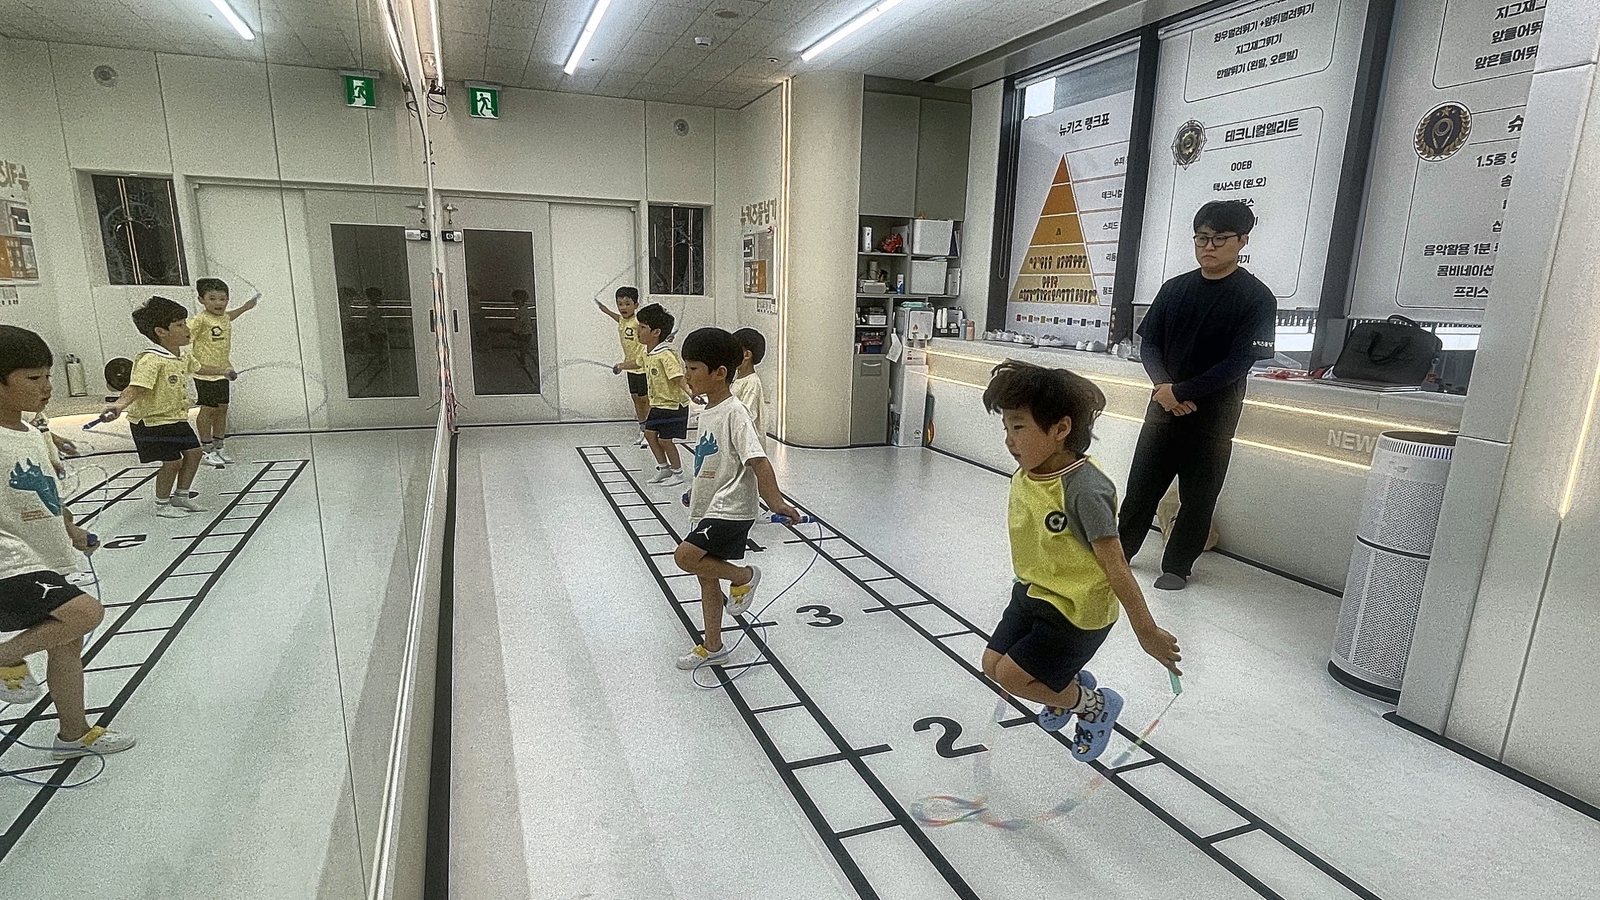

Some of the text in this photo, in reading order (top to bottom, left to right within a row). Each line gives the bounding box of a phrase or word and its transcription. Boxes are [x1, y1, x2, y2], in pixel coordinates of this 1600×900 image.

[1235, 33, 1283, 55] 지그재그뛰기
[1216, 49, 1298, 79] 한발뛰기 (왼발, 오른발)
[1059, 119, 1083, 137] 뉴키즈
[1224, 117, 1299, 143] 테크니컬엘리트
[1476, 152, 1507, 167] 1.5중
[1424, 243, 1470, 256] 음악활용
[1473, 243, 1491, 255] 1분
[1453, 286, 1489, 299] 프리스
[1326, 429, 1377, 453] NEW
[796, 604, 844, 628] 3
[912, 716, 989, 759] 2
